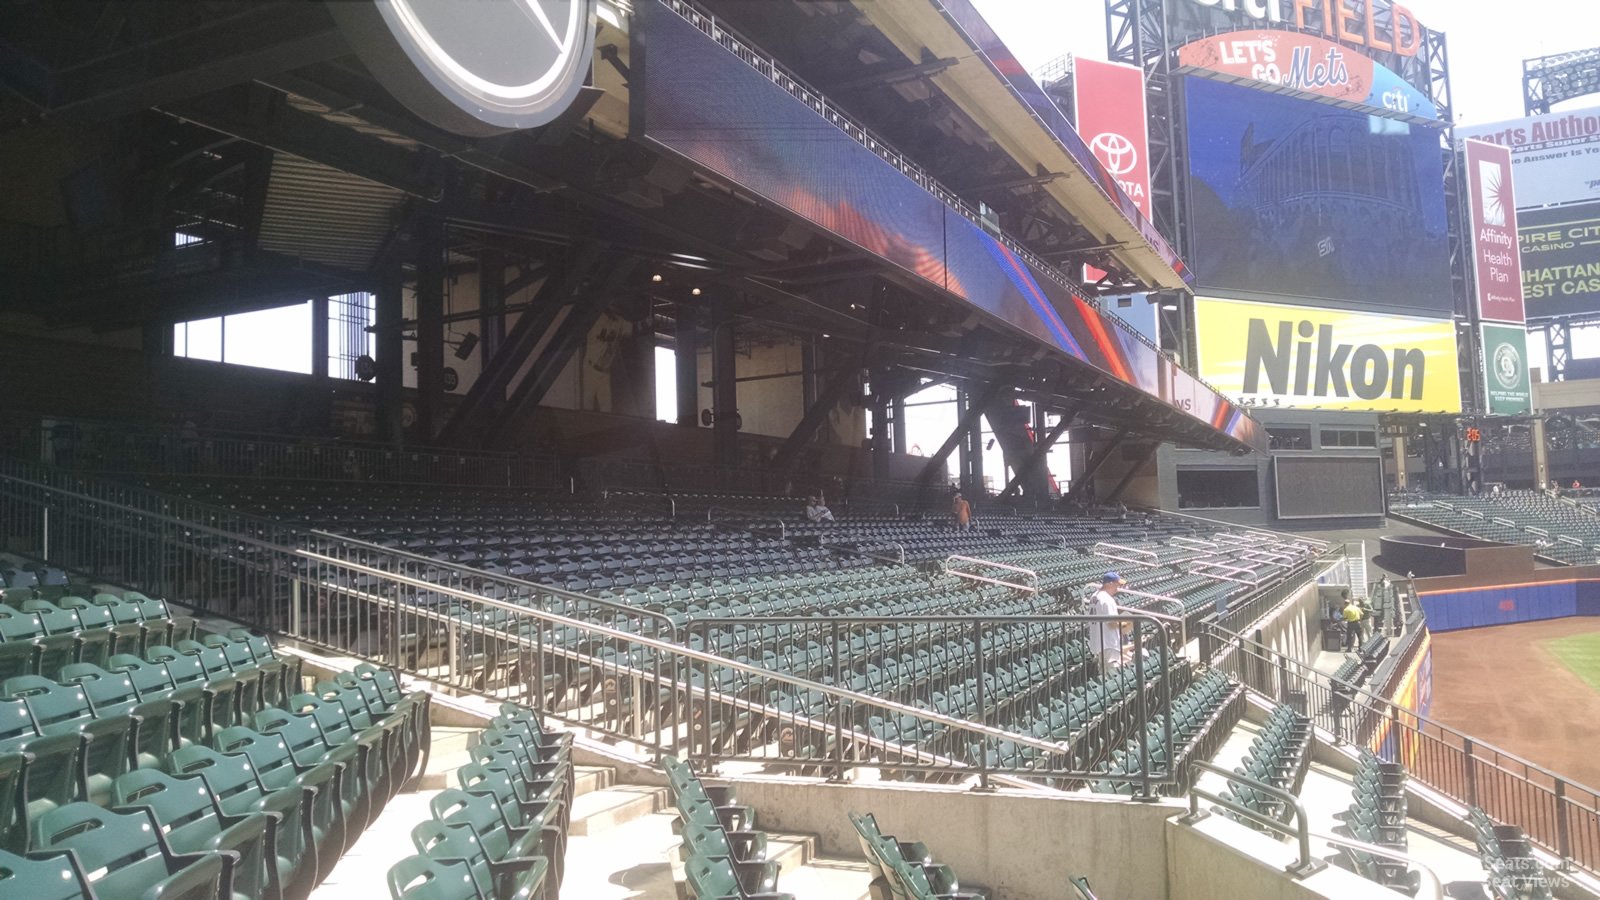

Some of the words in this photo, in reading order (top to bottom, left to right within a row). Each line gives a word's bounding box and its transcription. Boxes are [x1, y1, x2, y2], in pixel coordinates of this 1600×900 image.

[1219, 40, 1277, 65] LET'S
[1252, 63, 1281, 84] GO
[1281, 45, 1349, 89] Mets
[1382, 89, 1409, 112] citi
[1469, 127, 1526, 146] rts
[1531, 113, 1600, 143] Autho
[1523, 151, 1568, 163] Answer
[1480, 229, 1513, 249] Affinity
[1521, 242, 1575, 253] CASINO
[1483, 249, 1513, 267] Health
[1489, 266, 1509, 283] Plan
[1243, 318, 1425, 401] Nikon
